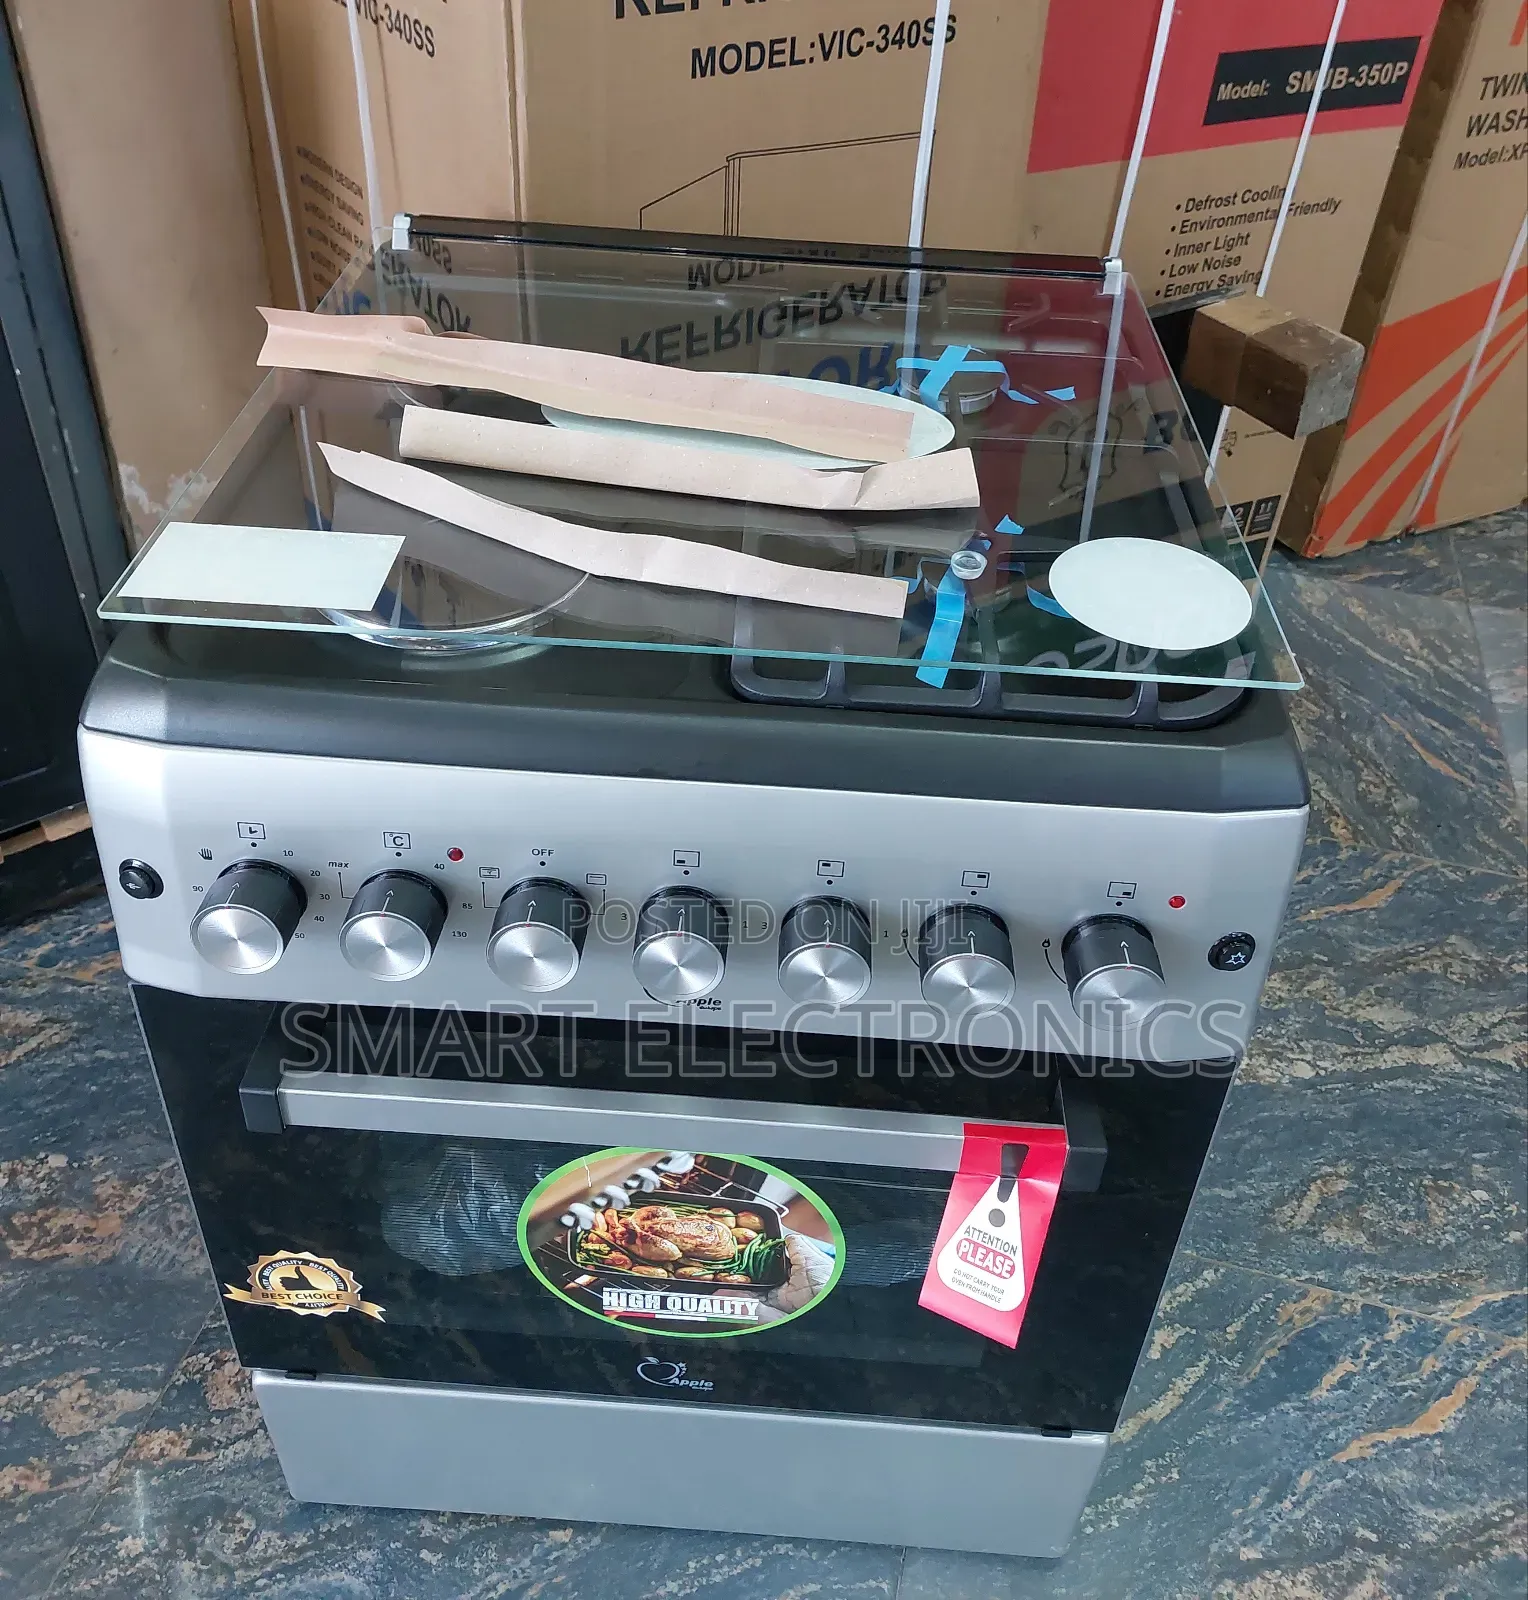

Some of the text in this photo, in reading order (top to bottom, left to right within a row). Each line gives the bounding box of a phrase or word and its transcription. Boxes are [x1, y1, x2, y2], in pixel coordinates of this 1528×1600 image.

[1217, 79, 1270, 101] Model:
[1184, 185, 1287, 213] Defrost Coolin
[1179, 205, 1281, 235] Environmenta
[1173, 232, 1251, 258] Inner Light
[1168, 254, 1242, 279] Low Noise
[531, 848, 554, 857] OFF
[328, 861, 350, 869] max
[319, 893, 331, 901] 30
[452, 930, 468, 938] 130
[964, 1225, 1018, 1256] ATTENTION
[958, 1239, 1014, 1279] PLEASE
[261, 1292, 344, 1301] BEST CHOICE
[603, 1291, 759, 1316] HIGH QUALITY
[668, 1377, 714, 1387] Apple
